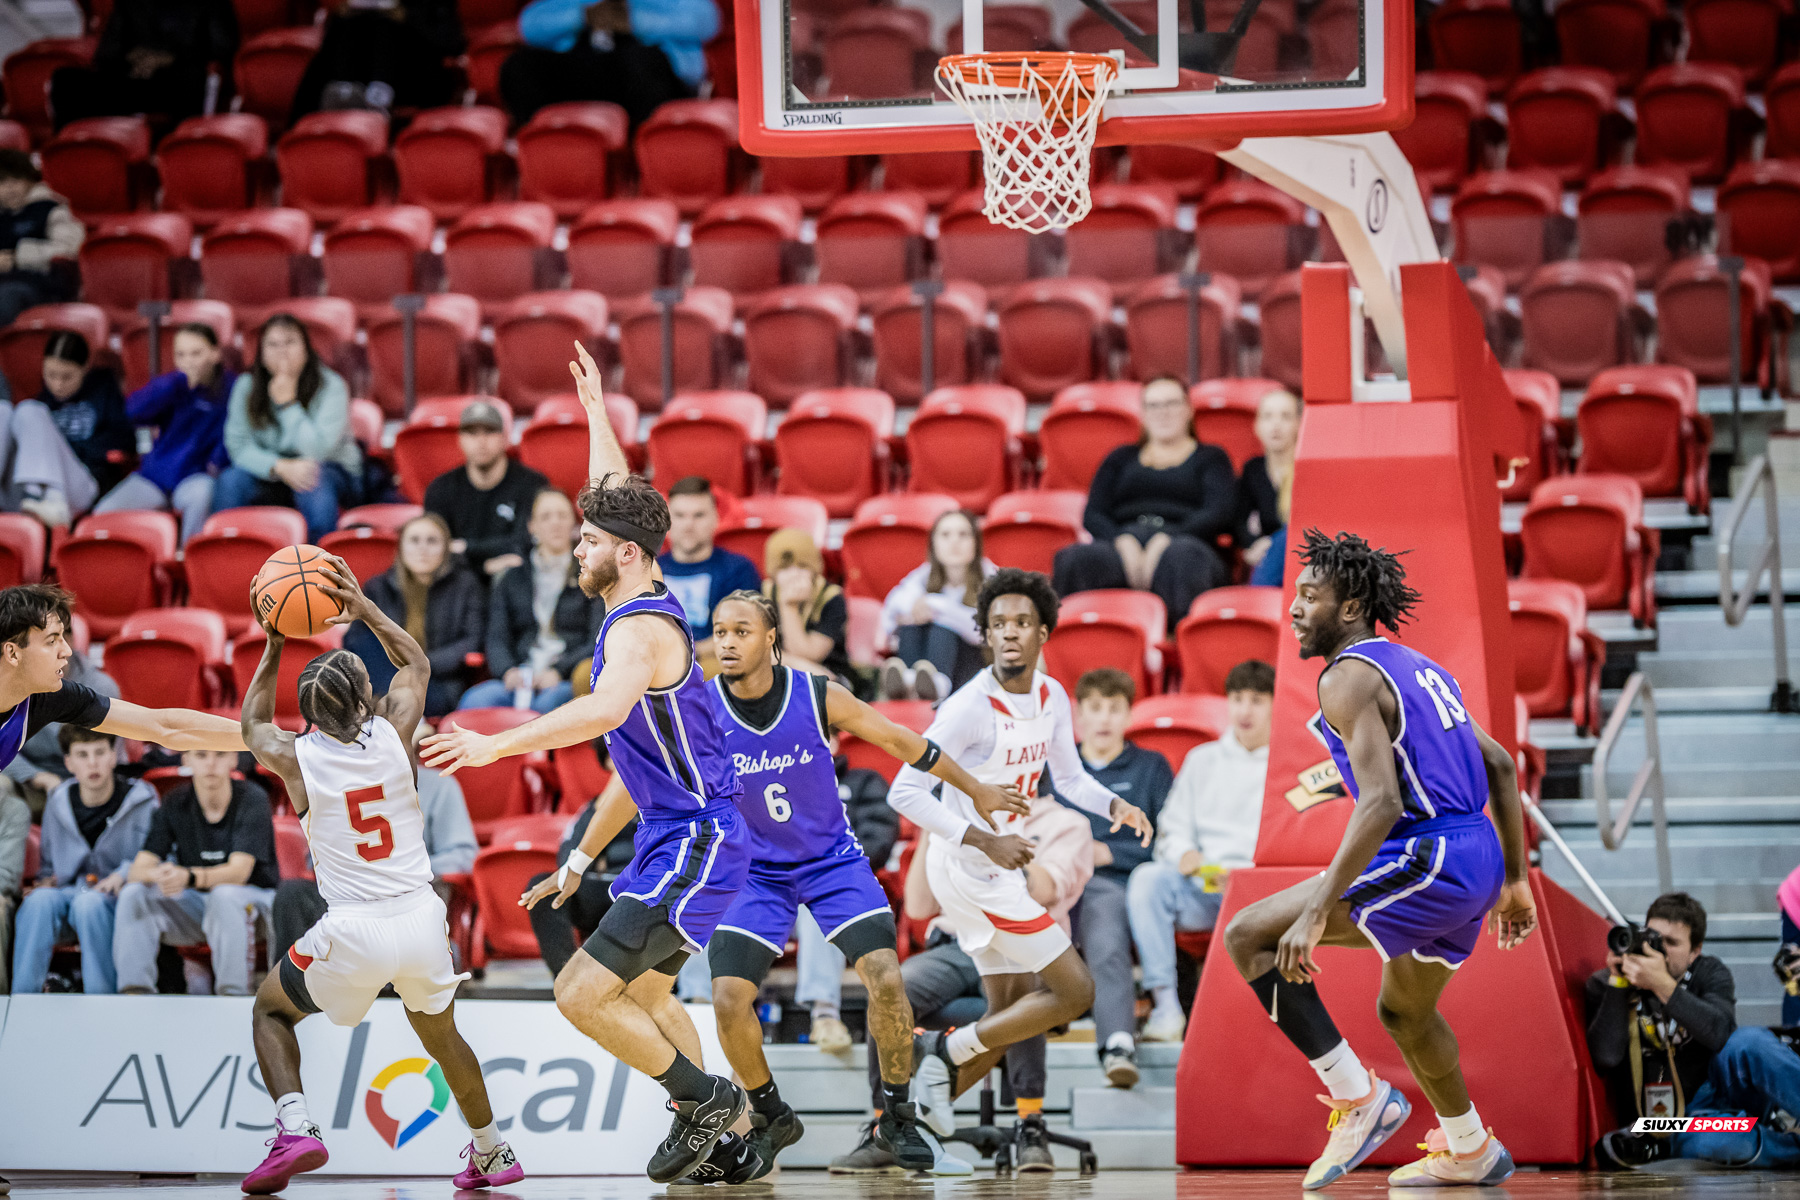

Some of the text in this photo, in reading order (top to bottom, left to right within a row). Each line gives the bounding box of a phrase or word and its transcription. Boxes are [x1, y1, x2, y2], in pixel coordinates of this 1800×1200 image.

[783, 112, 842, 127] SPALDING
[732, 744, 813, 776] Bishop's
[1005, 741, 1049, 766] LAVA
[763, 783, 793, 823] 6
[343, 783, 396, 863] 5
